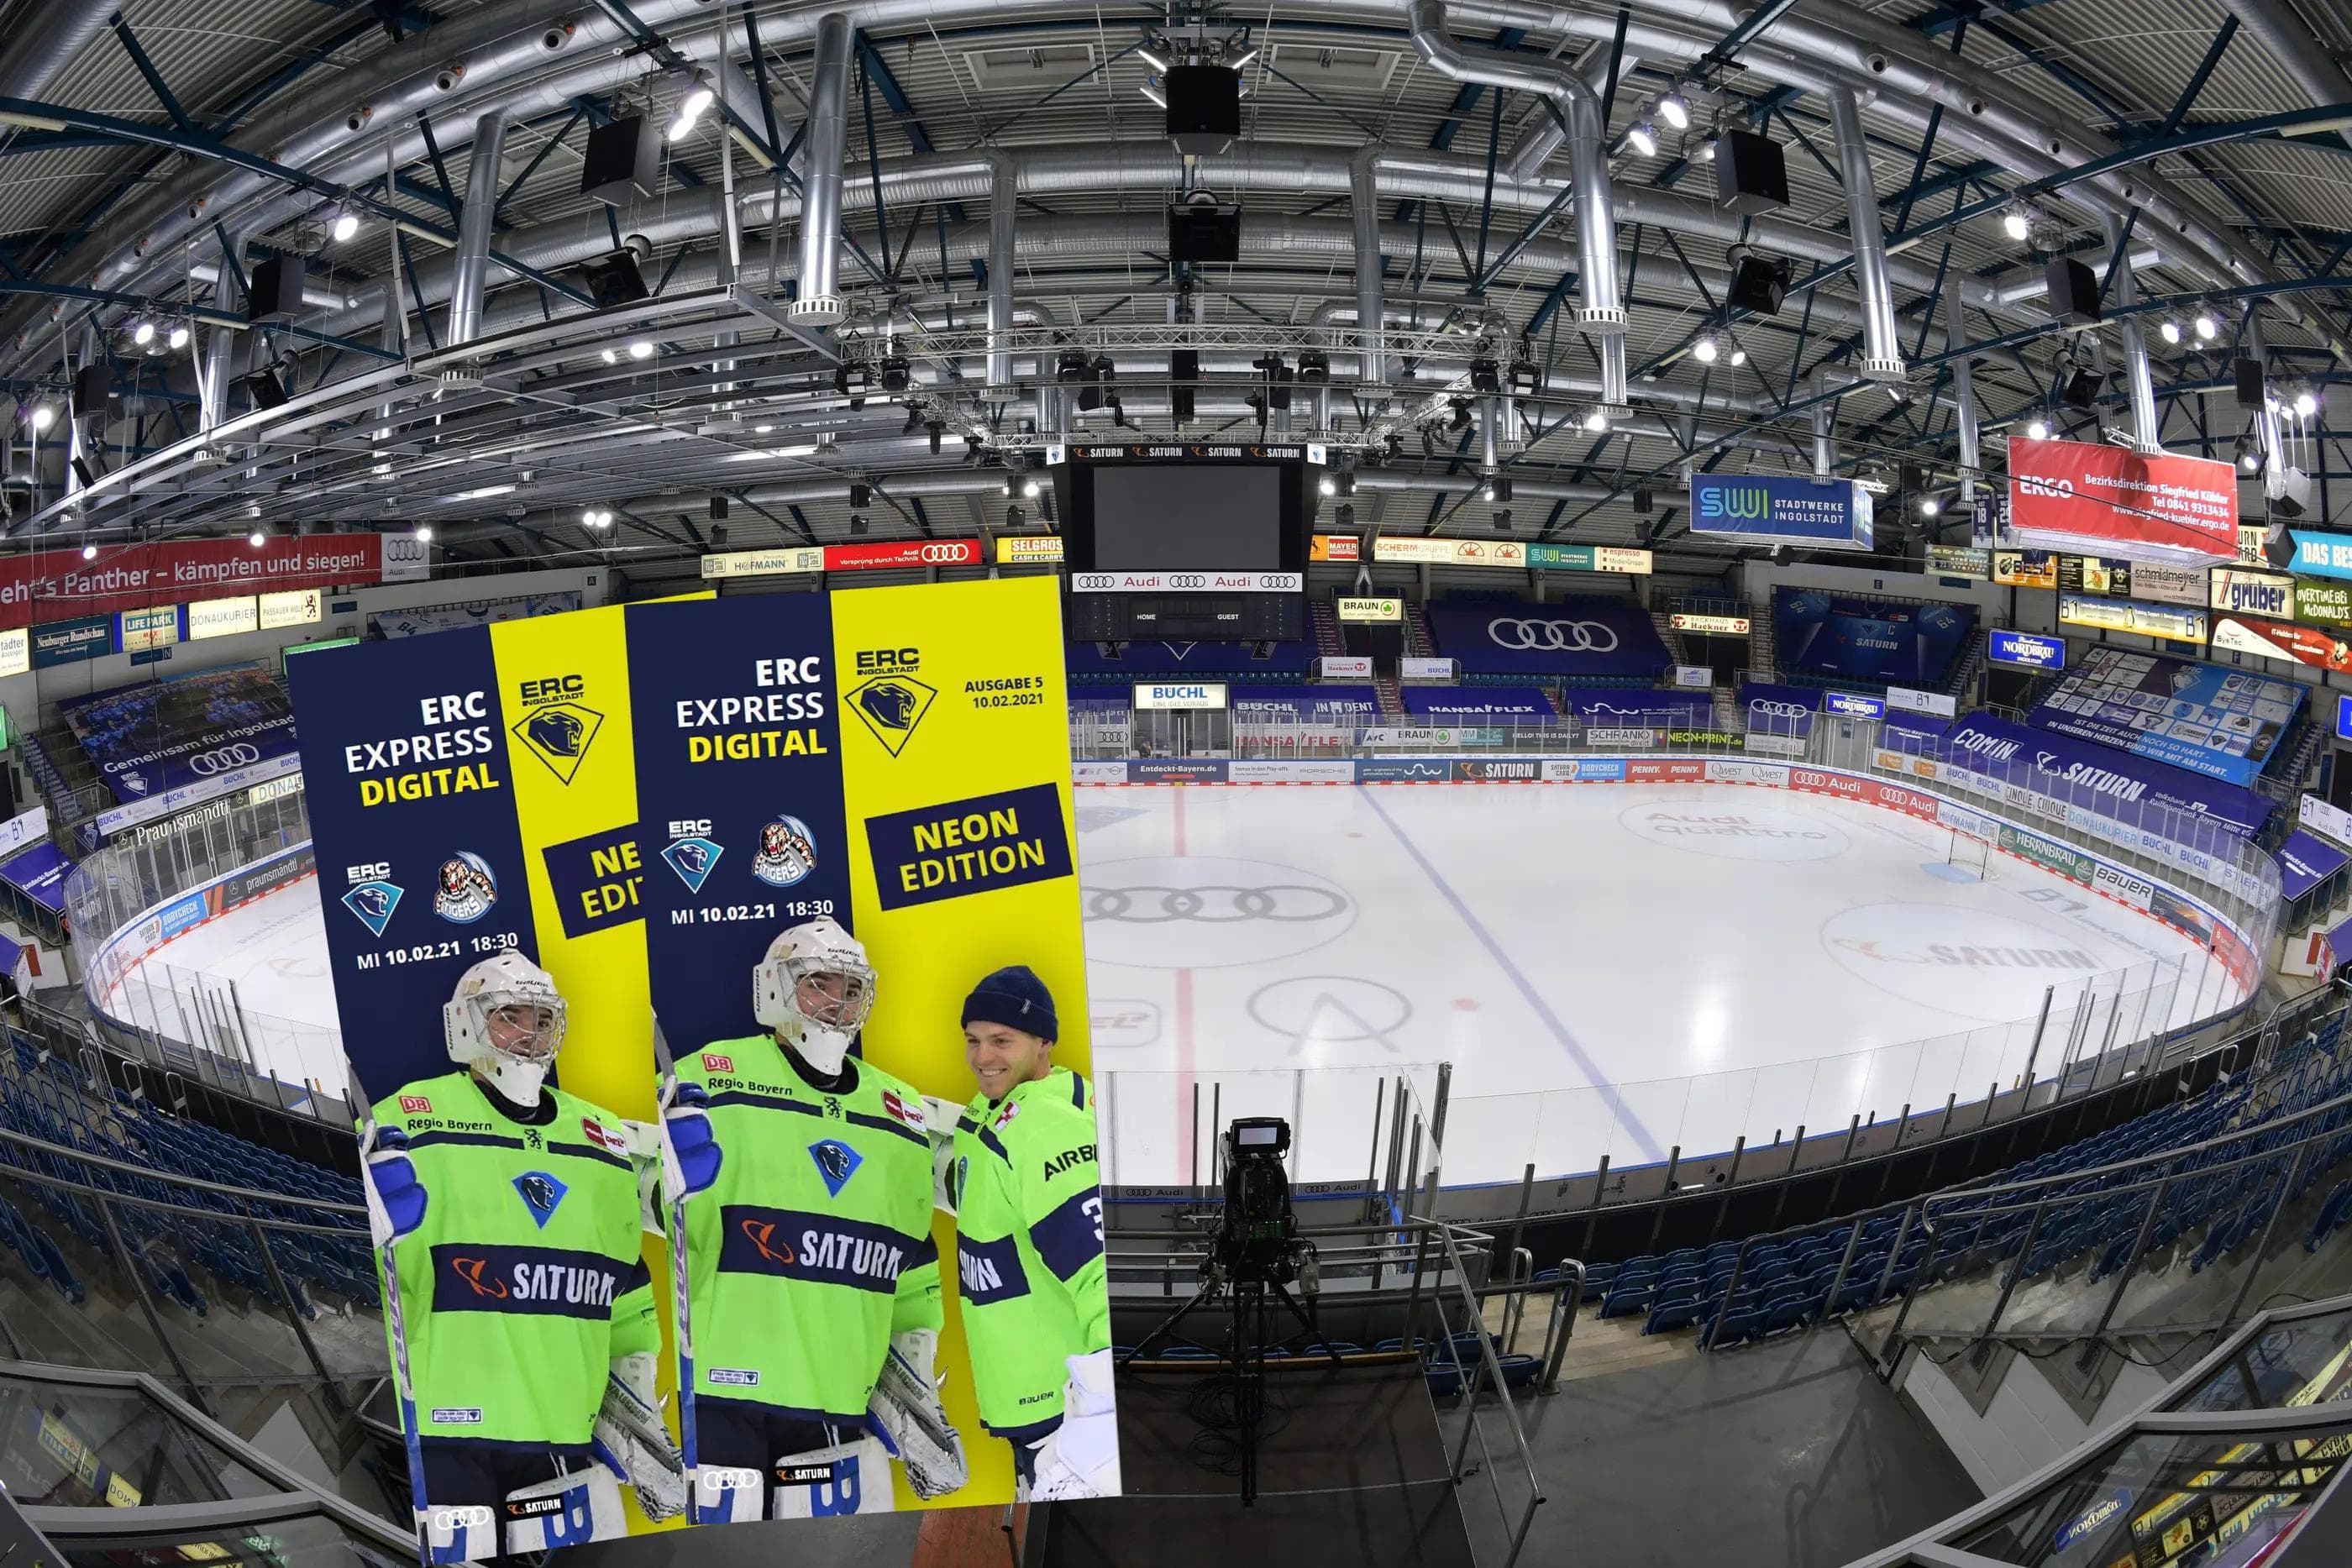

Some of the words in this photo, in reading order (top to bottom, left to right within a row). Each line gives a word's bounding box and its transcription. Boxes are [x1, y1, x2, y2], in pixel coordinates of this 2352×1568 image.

[1090, 448, 1123, 458] SATURN
[1149, 447, 1183, 457] SATURN
[1208, 447, 1242, 458] SATURN
[1267, 448, 1300, 459] SATURN
[2019, 475, 2073, 499] ERGO
[2085, 475, 2158, 494] Bezirksdirektion
[2160, 484, 2200, 500] Siegfried
[2201, 490, 2229, 504] Kübler
[1699, 487, 1768, 519] SWI
[1774, 499, 1844, 511] STADTWERKE
[2152, 497, 2166, 508] Tel
[2166, 499, 2189, 511] 0841
[2191, 502, 2229, 517] 9313434
[1775, 511, 1845, 524] INGOLSTADT
[1977, 508, 1987, 523] 18
[1011, 538, 1063, 552] SELGROS
[1531, 548, 1559, 563] SWI
[1609, 548, 1641, 558] espresso
[2302, 542, 2328, 565] DAS
[840, 557, 874, 565] Vorsprung
[64, 567, 150, 595] Panther
[175, 558, 262, 582] kämpfen
[268, 553, 302, 573] und
[307, 550, 365, 573] siegen!
[389, 568, 406, 576] Audi
[1538, 572, 1545, 580] D
[1124, 575, 1160, 587] Audi
[1215, 575, 1251, 587] Audi
[2230, 579, 2286, 612] gruber
[1343, 601, 1379, 611] BRAUN
[127, 618, 148, 631] LIFE
[150, 614, 172, 627] PARK
[191, 607, 257, 627] DONAUKURIER
[1690, 622, 1729, 632] Hackner
[37, 633, 70, 647] Neuburger
[70, 628, 106, 642] Rundschau
[1856, 637, 1898, 650] SATURN
[1152, 686, 1208, 699] BÜCHL
[1236, 702, 1298, 712] BÜCHL
[1345, 702, 1373, 713] DENT
[1398, 730, 1434, 739] BRAUN
[2073, 718, 2087, 728] IST
[2087, 721, 2101, 731] DIE
[2100, 723, 2118, 735] ZEIT
[2118, 728, 2142, 741] AUCH
[2142, 736, 2167, 749] NOCH
[2168, 742, 2179, 753] SO
[2181, 746, 2206, 759] HART
[103, 741, 201, 774] Gemeinsam
[201, 732, 225, 747] für
[2057, 722, 2092, 738] UNSEREN
[2092, 732, 2124, 747] HERZEN
[2124, 741, 2146, 753] SIND
[2146, 747, 2165, 758] WIR
[2165, 751, 2182, 763] MIT
[2181, 756, 2198, 768] AM
[2197, 761, 2228, 777] START.
[1140, 765, 1217, 774] Entdeckt-Bayern.de
[1485, 763, 1534, 779] SATURN
[1829, 778, 1861, 793] Audi
[2062, 761, 2148, 803] SATURN
[1909, 796, 1935, 814] Audi
[2154, 791, 2187, 806] Volksbank
[2197, 811, 2222, 829] Bayern
[2223, 820, 2241, 833] Mitte
[2016, 831, 2076, 866] HERRNBRÄU
[246, 857, 299, 893] praunsmändtl
[2096, 868, 2152, 899] BAUER
[1927, 941, 2101, 970] SATURN
[707, 1056, 730, 1070] DB
[708, 1078, 744, 1091] Regio
[748, 1082, 793, 1096] Bayern
[403, 1097, 428, 1112] DB
[407, 1119, 444, 1131] Regio
[448, 1120, 493, 1131] Bayern
[1044, 1143, 1097, 1183] AIRB
[800, 1230, 903, 1282] SATURN
[513, 1262, 617, 1307] SATURN
